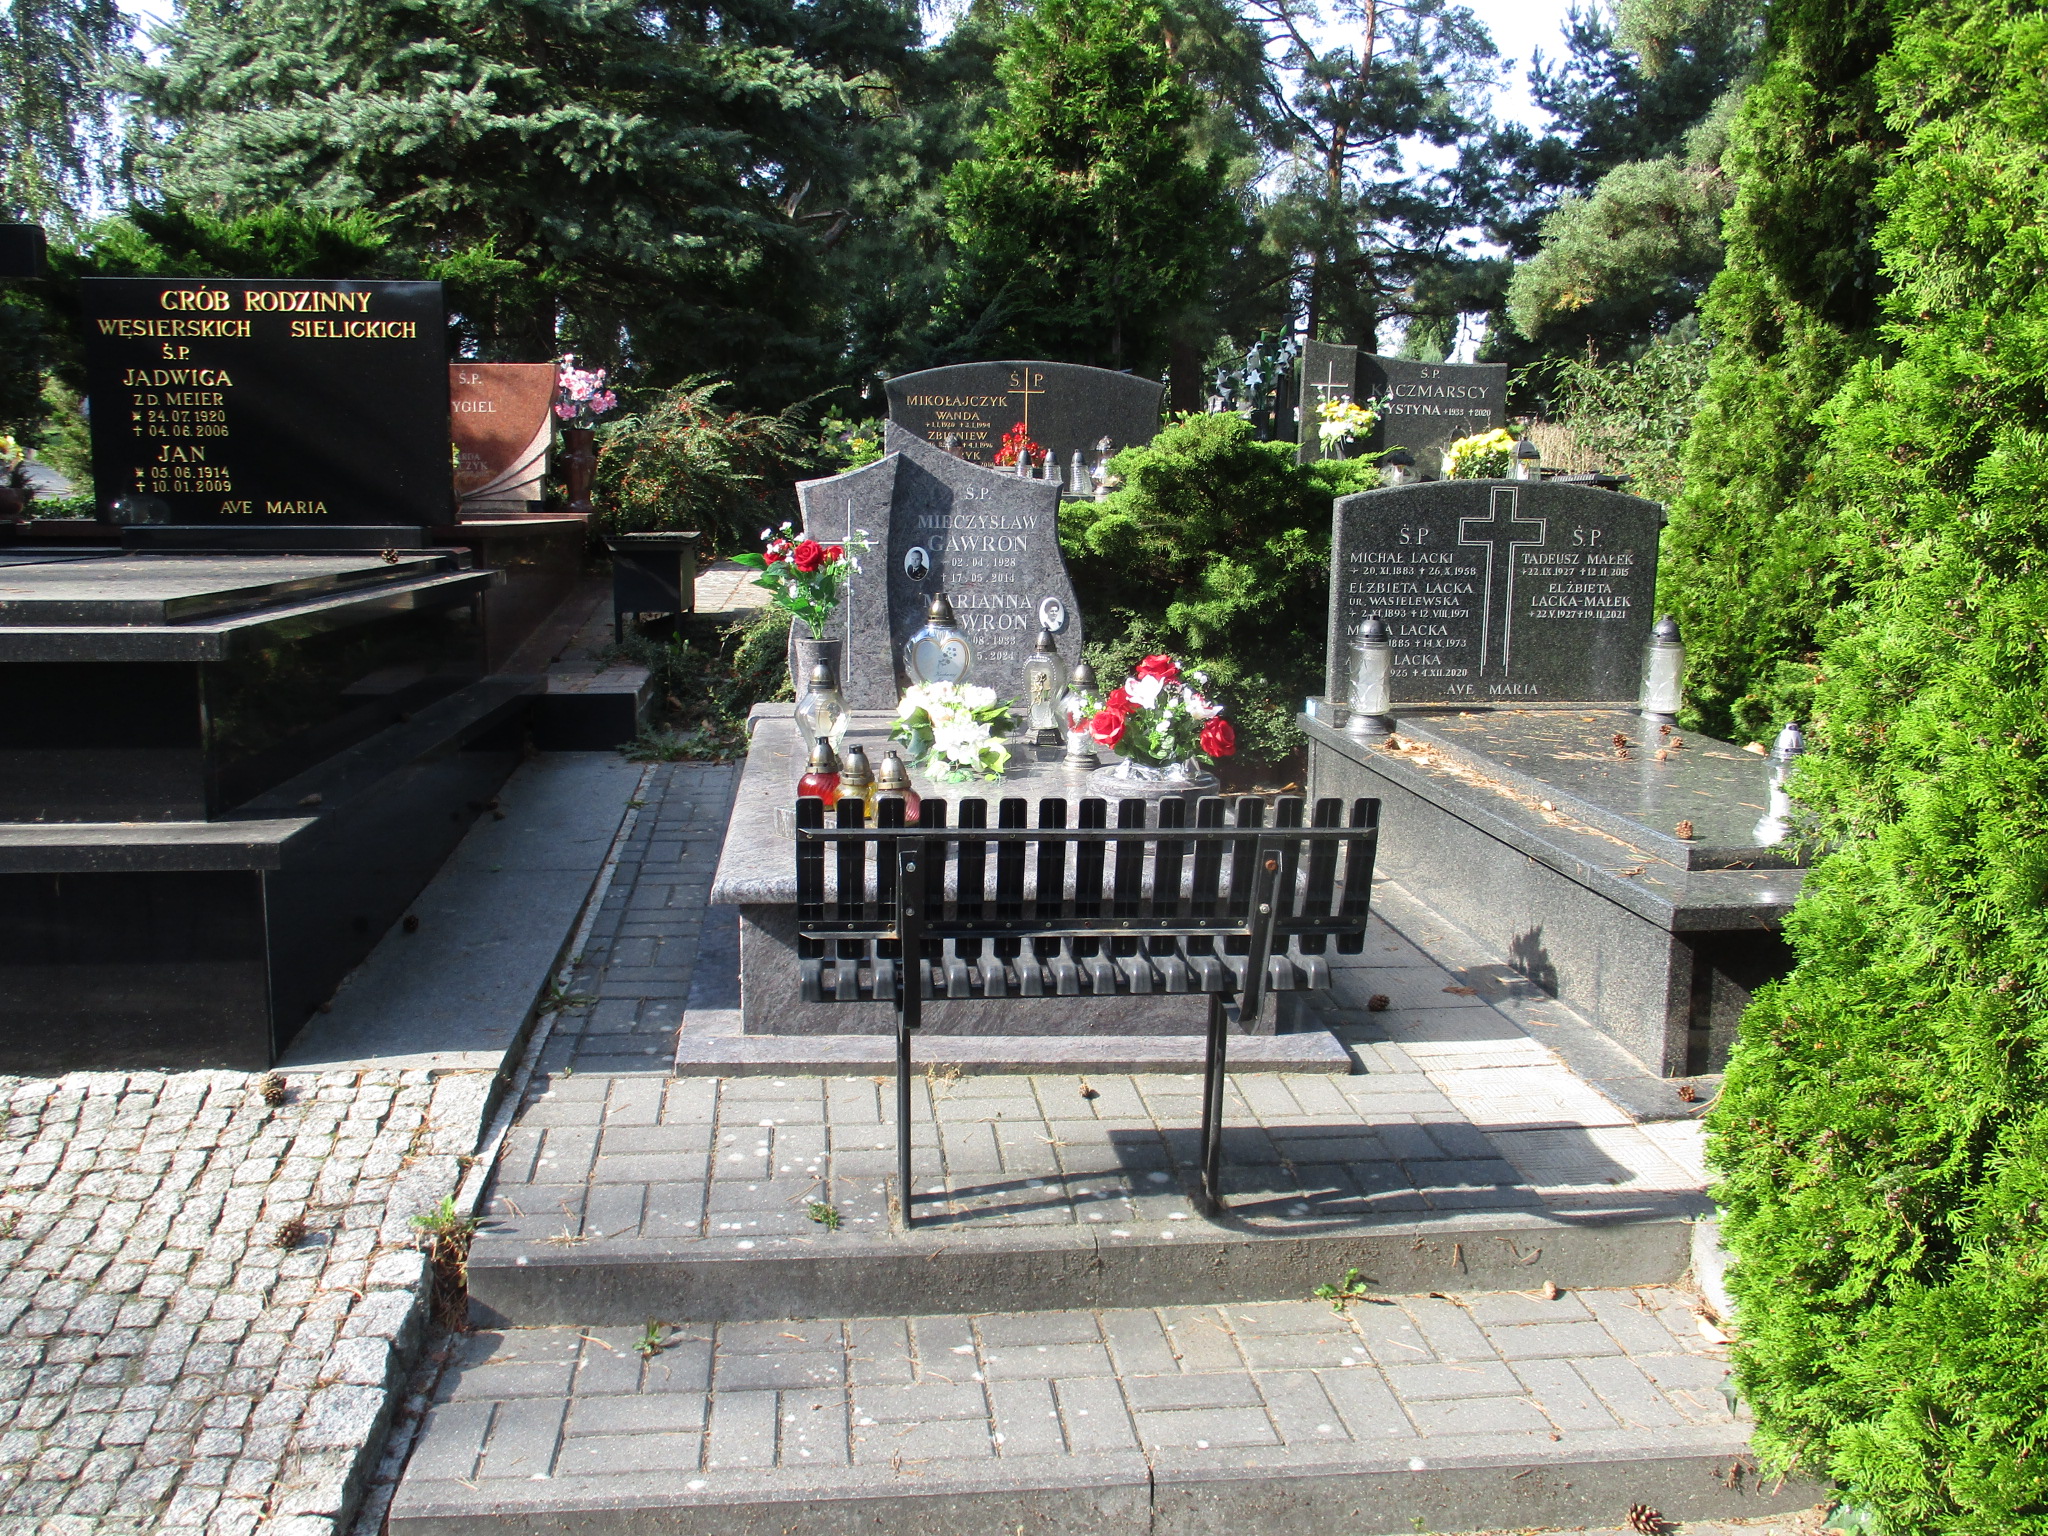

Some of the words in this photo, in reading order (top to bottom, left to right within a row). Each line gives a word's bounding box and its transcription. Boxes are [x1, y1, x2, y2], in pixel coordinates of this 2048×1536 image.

[161, 285, 230, 311] GRÓB
[244, 291, 371, 313] RODZINNY
[97, 319, 251, 339] WĘSIERSKICH
[291, 320, 416, 339] SIELICKICH
[122, 368, 233, 386] JADWIGA
[1371, 383, 1489, 399] KACZMARSCY
[166, 392, 224, 406] MEIER
[906, 395, 1008, 407] MIKOŁAJCZYK
[452, 402, 497, 413] YGIEL
[1385, 403, 1441, 416] YSTYNA
[1474, 409, 1491, 417] 2020
[148, 410, 226, 423] 24.07.1920
[936, 412, 980, 421] WANDA
[149, 425, 229, 437] 04.06.2006
[158, 445, 205, 463] JAN
[151, 466, 229, 478] 05.06.1914
[152, 480, 232, 492] 10.01.2009
[220, 501, 252, 514] AVE
[267, 501, 328, 514] MARIA
[918, 514, 1038, 530] MIECZYSŁAW
[928, 535, 1028, 552] GAWRON
[1350, 552, 1404, 564] MICHAŁ
[1411, 552, 1453, 564] LACKI
[1521, 553, 1580, 565] TADEUSZ
[1587, 553, 1634, 565] MAŁEK
[1425, 582, 1473, 594] LACKA
[1549, 580, 1612, 593] ELŻBIETA
[1369, 596, 1459, 606] WASIELEWSKA
[1531, 596, 1632, 607] LACKA-MAŁEK
[961, 614, 1028, 630] WRON
[1401, 624, 1448, 636] LACKA
[1394, 654, 1441, 666] LACKA
[1447, 684, 1475, 695] AVE
[1489, 684, 1538, 695] MARIA
